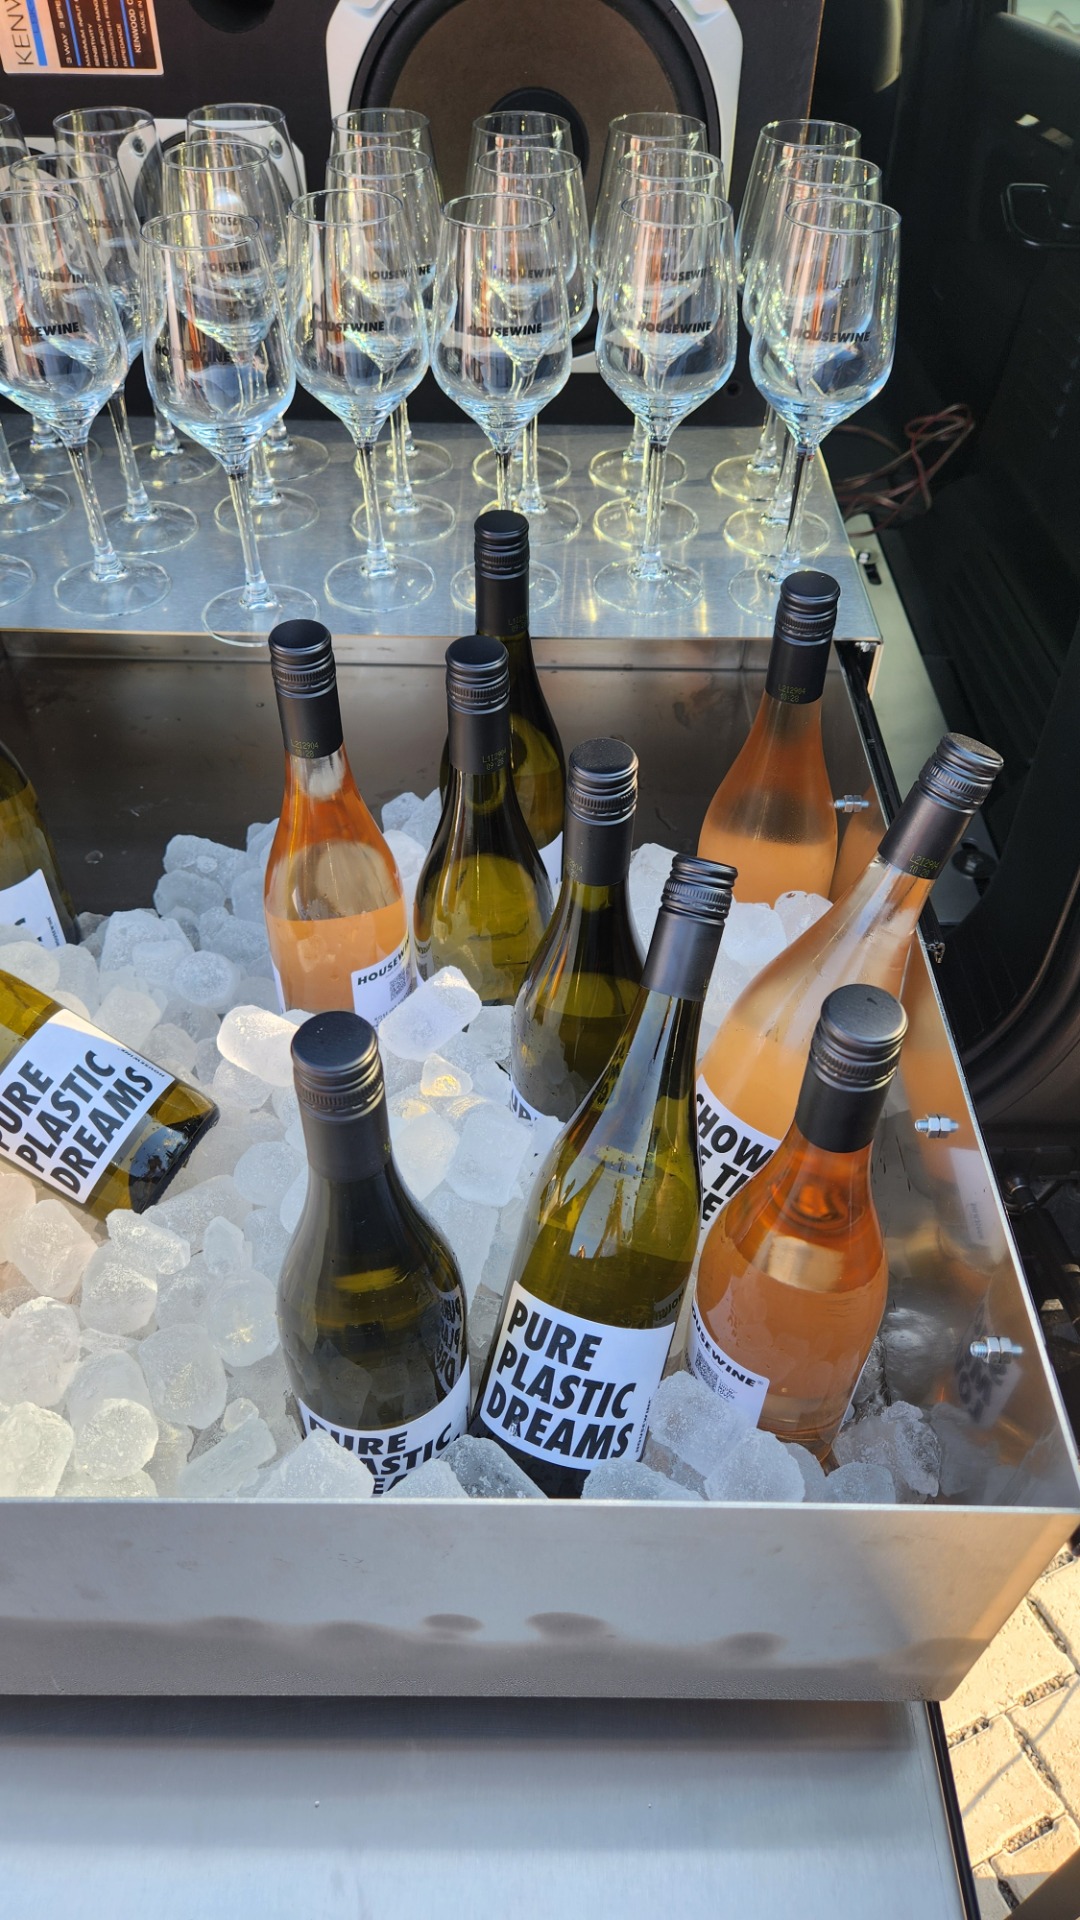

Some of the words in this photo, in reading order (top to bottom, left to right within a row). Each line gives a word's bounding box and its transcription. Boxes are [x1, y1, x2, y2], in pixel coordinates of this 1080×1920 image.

[74, 3, 85, 28] INPUT
[128, 9, 141, 54] KENWOOD
[139, 11, 147, 35] MADE
[62, 33, 73, 55] WAY
[79, 29, 92, 67] MAXIMUM
[87, 23, 101, 67] SENSITIVITY
[97, 23, 109, 67] FREQUENCY
[106, 20, 118, 67] CROSSOVER
[115, 23, 128, 67] IMPEDANCE
[467, 323, 543, 337] HOUSEWINE
[637, 321, 712, 334] HOUSEWINE
[793, 328, 871, 342] HOUSEWINE
[15, 1050, 116, 1174] PLASTIC
[50, 1066, 153, 1194] DREAMS
[507, 1299, 602, 1371] PURE
[496, 1340, 637, 1418] PLASTIC
[486, 1380, 634, 1460] DREAMS
